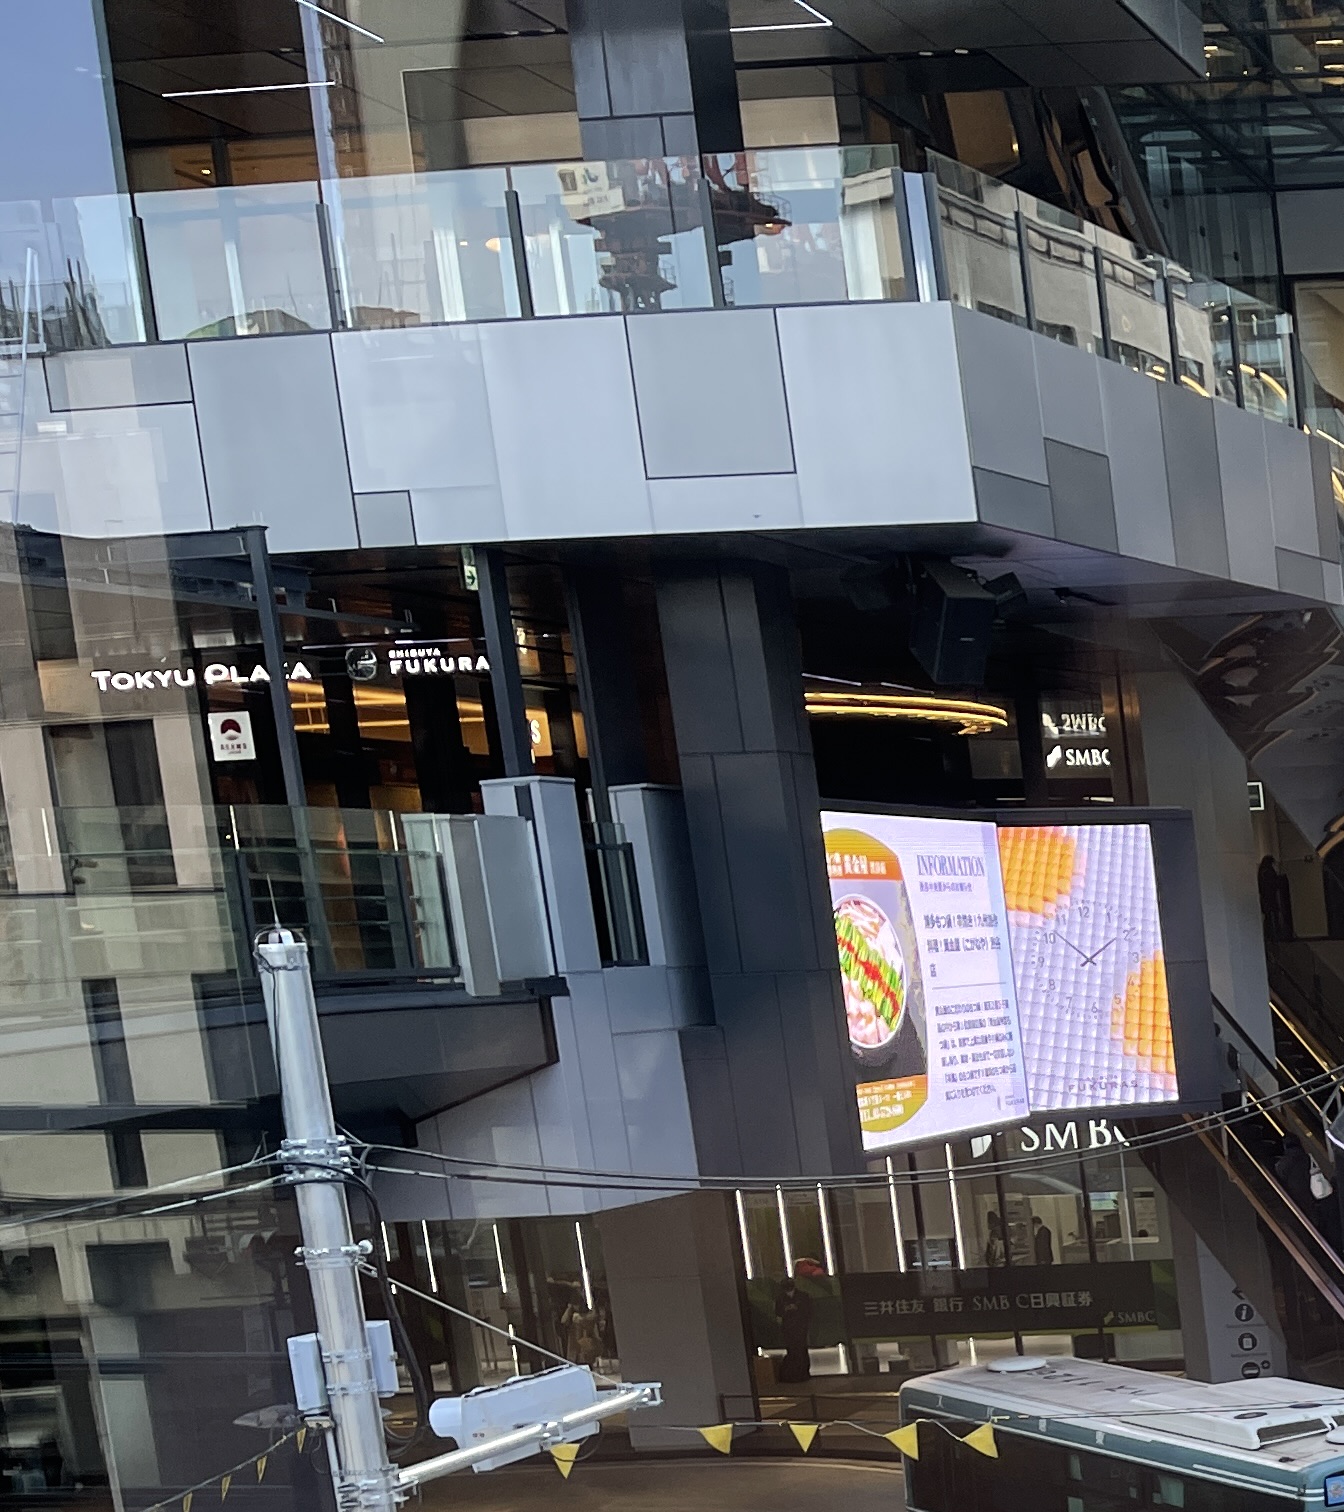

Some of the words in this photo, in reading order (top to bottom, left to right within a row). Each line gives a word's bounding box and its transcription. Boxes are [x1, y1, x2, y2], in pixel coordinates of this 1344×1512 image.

[389, 655, 491, 676] FUKURA
[90, 668, 196, 693] TOKYU
[1065, 748, 1111, 766] SMBC
[917, 854, 985, 877] INFORMATION
[1117, 1310, 1156, 1324] SMBC
